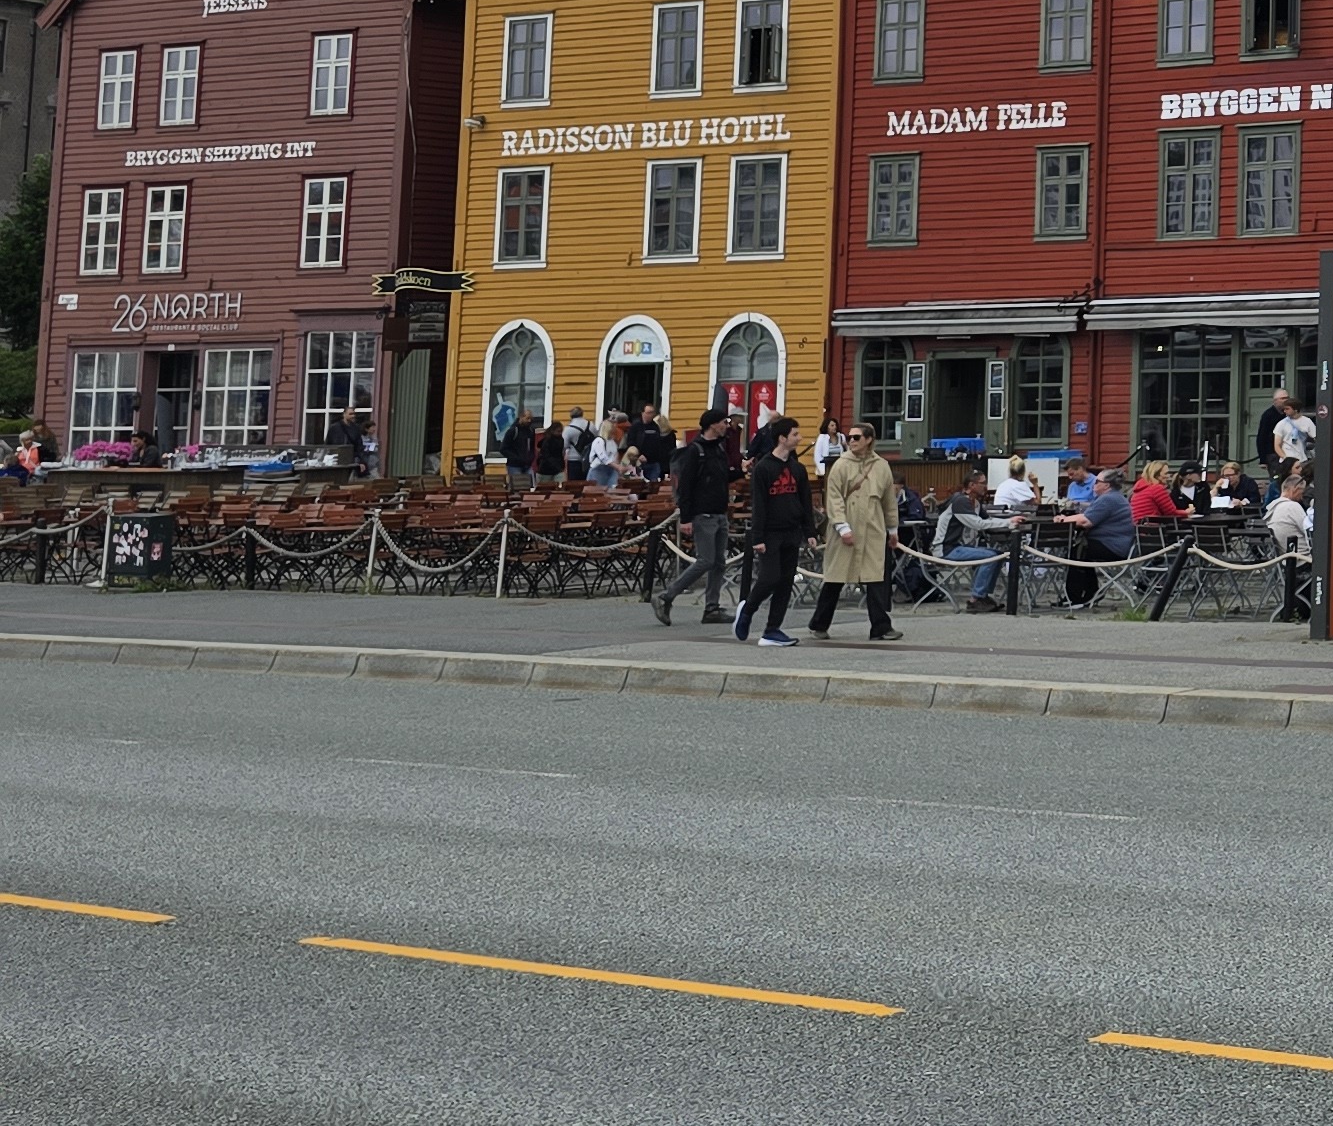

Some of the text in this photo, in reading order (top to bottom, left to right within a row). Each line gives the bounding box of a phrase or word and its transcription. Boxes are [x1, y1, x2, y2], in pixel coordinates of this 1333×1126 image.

[886, 101, 1067, 136] MADAM FELLE
[1160, 85, 1301, 119] BRYGGEN
[501, 114, 791, 156] RADISSON BLU HOTEL
[125, 141, 316, 167] BRYGGEN SHIPPING INT
[111, 294, 148, 332] 26
